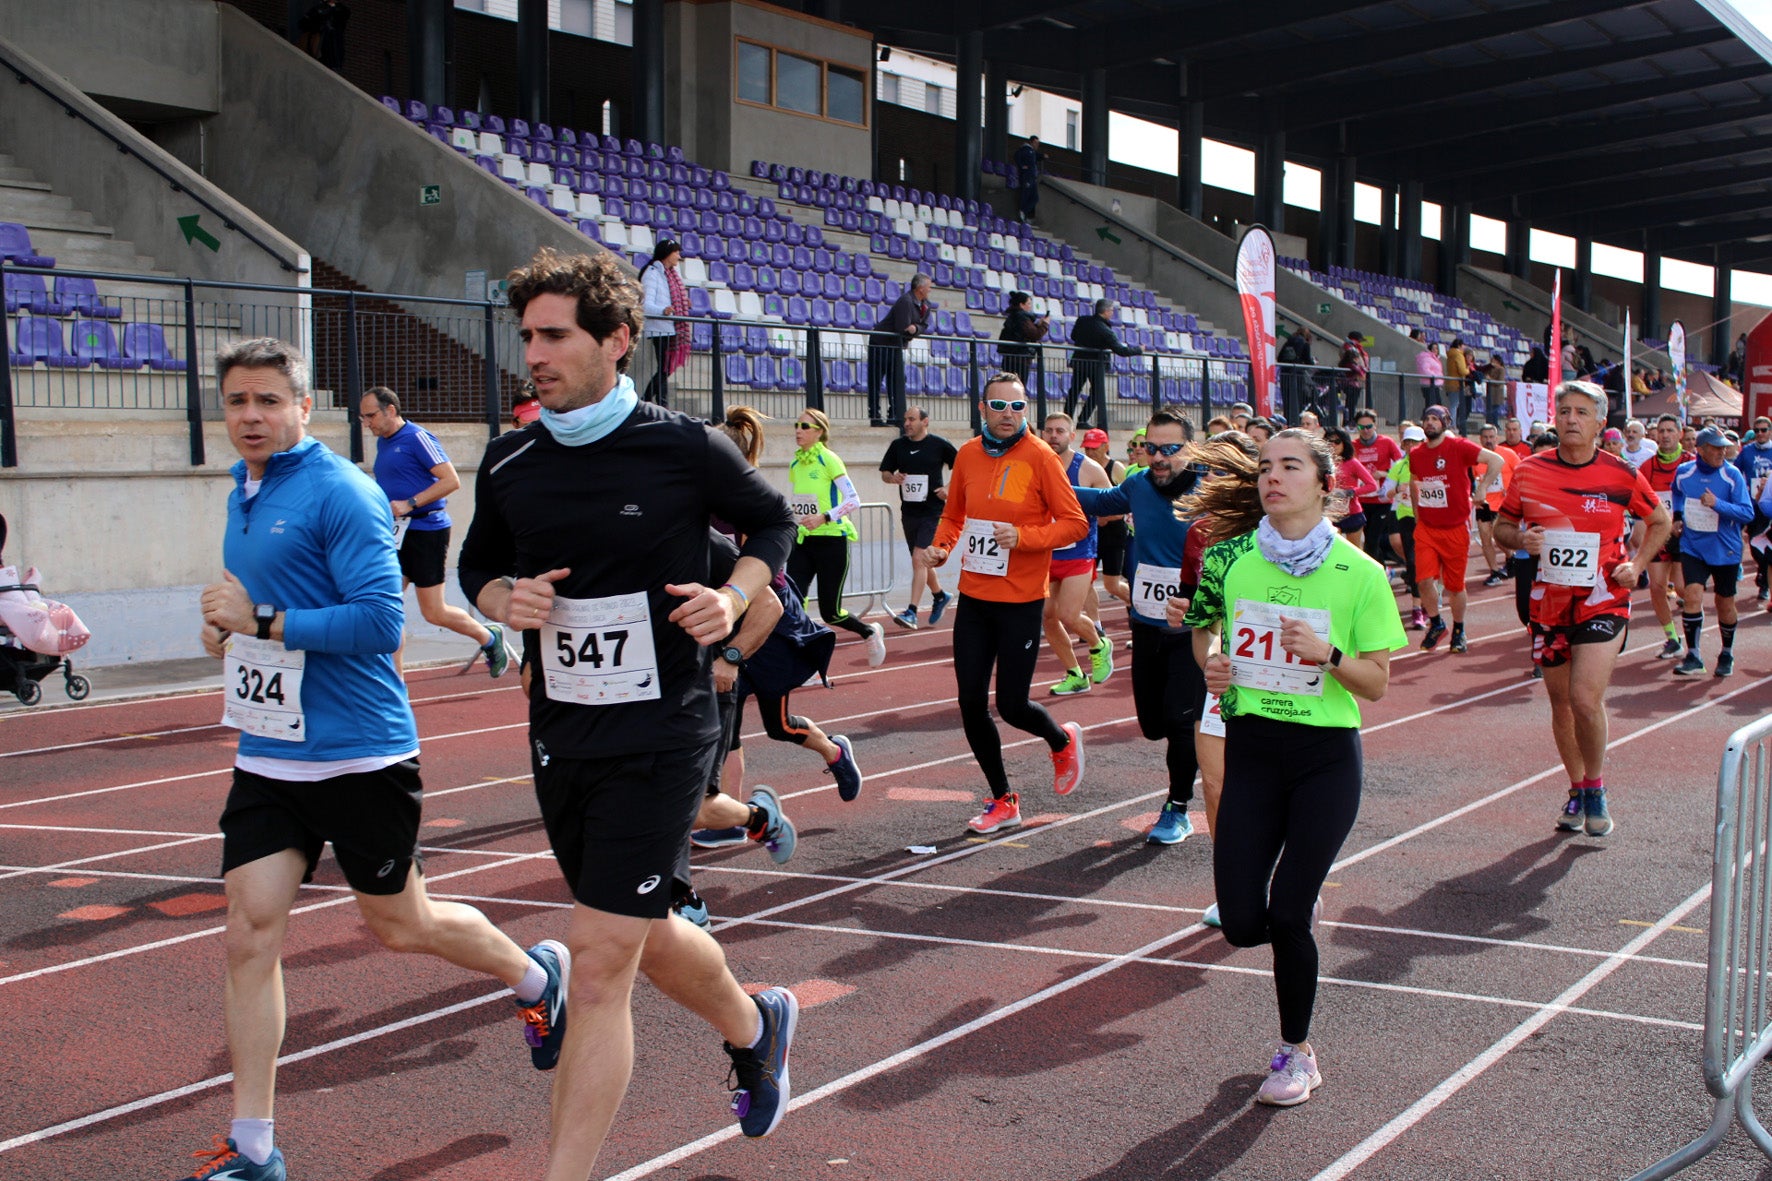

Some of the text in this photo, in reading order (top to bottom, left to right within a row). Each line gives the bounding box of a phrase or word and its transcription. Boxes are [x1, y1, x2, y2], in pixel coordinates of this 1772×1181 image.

[905, 483, 923, 494] 367
[968, 535, 999, 557] 912
[1549, 547, 1589, 568] 622
[557, 630, 629, 669] 547
[1235, 627, 1319, 667] 21
[236, 665, 285, 706] 324
[1260, 698, 1294, 708] carrera
